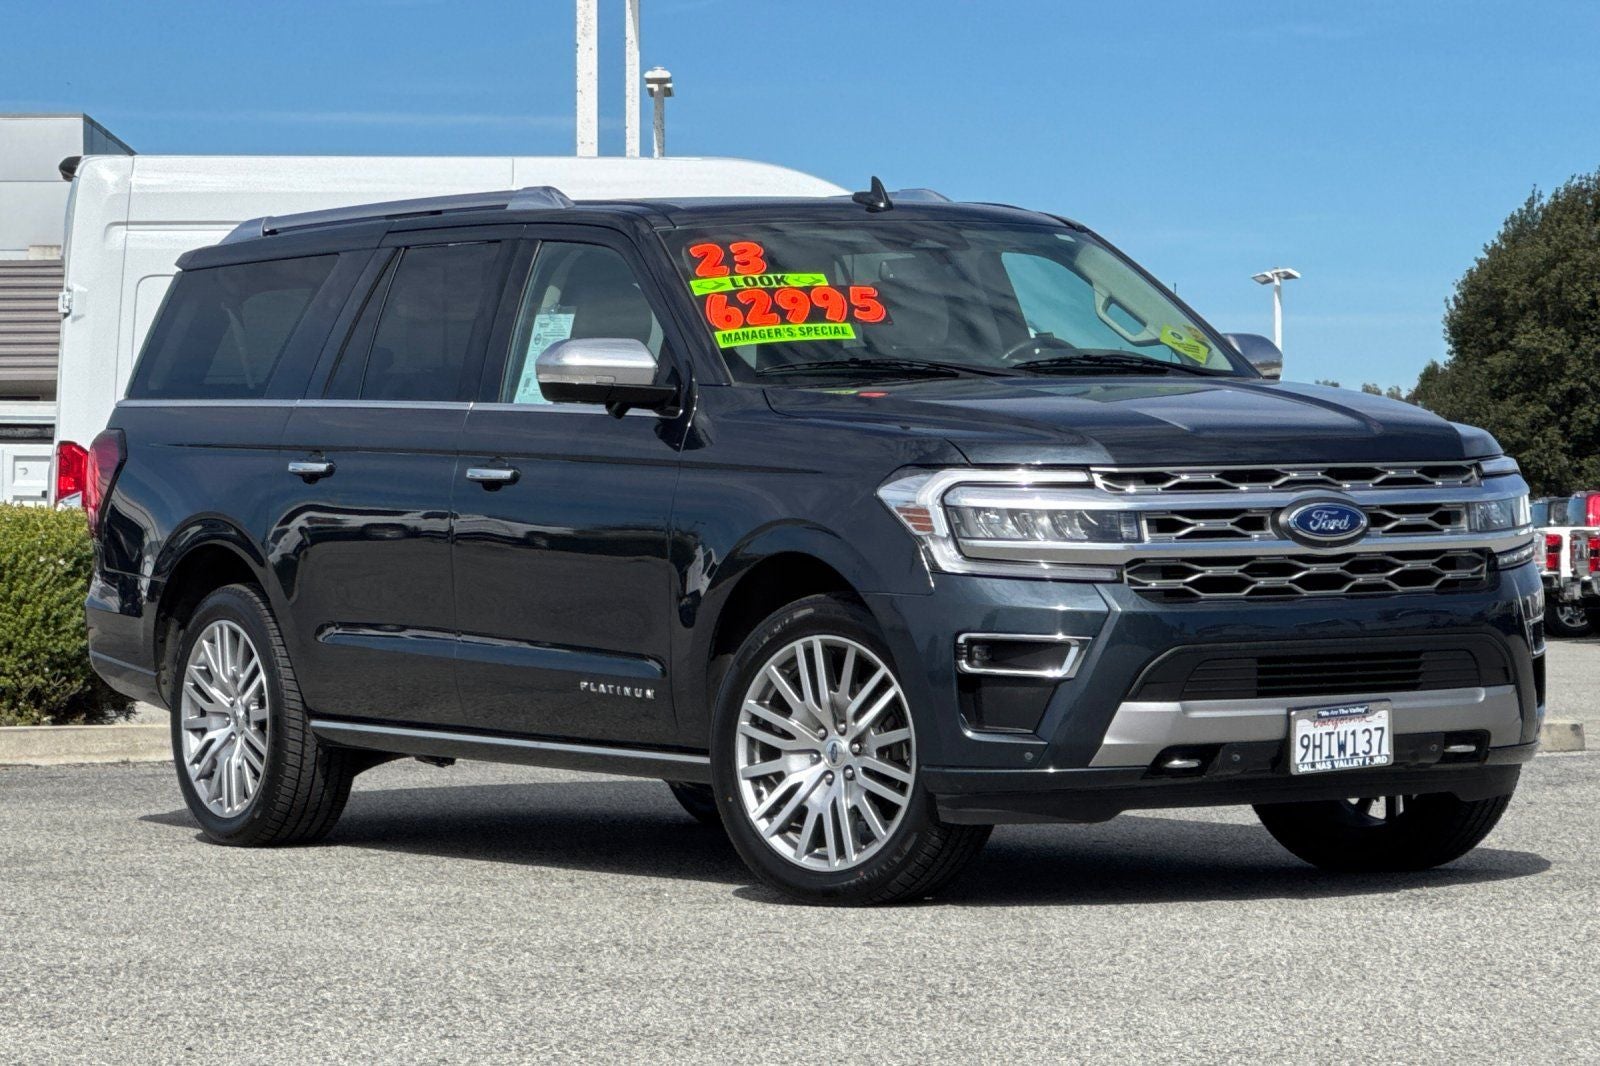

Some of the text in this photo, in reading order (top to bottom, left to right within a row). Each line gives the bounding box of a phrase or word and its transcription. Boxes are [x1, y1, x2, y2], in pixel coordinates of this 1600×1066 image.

[689, 241, 767, 277] 23
[729, 274, 788, 288] LOOK
[705, 286, 886, 330] 62995
[721, 326, 848, 344] MANAGER'S SPECIAL
[1309, 509, 1351, 531] Ford
[579, 681, 655, 699] PLATINUM
[1300, 727, 1385, 762] 9HIW137
[1334, 758, 1363, 769] VALLEY
